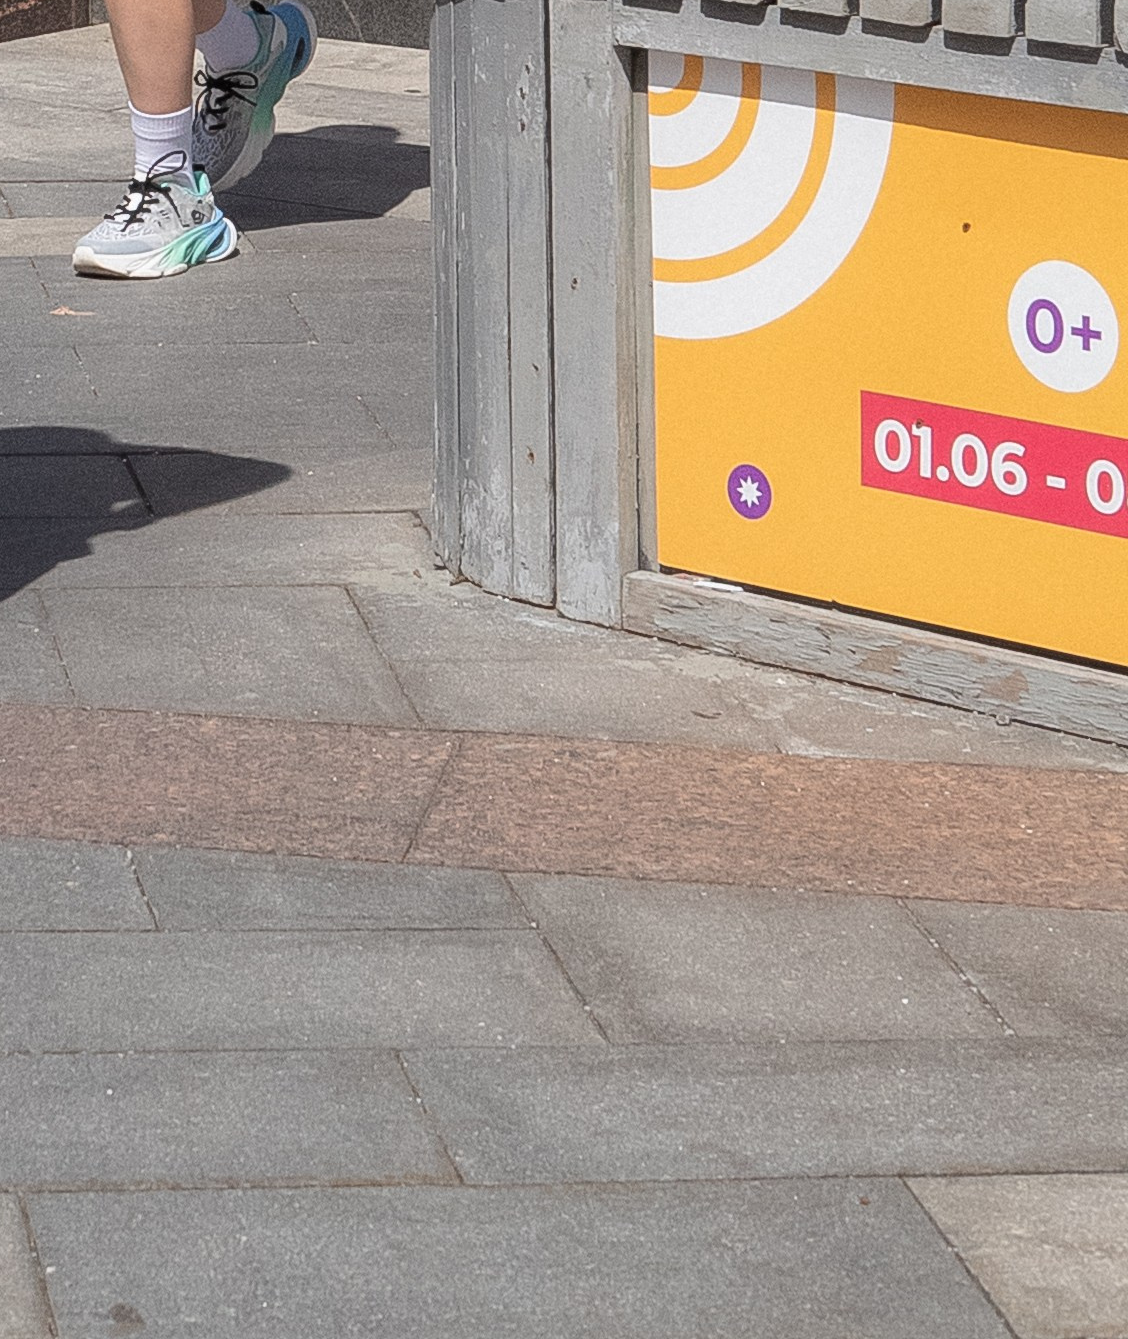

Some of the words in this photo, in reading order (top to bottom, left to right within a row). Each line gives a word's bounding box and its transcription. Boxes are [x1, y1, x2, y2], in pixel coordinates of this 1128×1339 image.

[1025, 298, 1103, 354] 0+
[874, 419, 1028, 496] 01.06
[1085, 459, 1128, 515] 0
